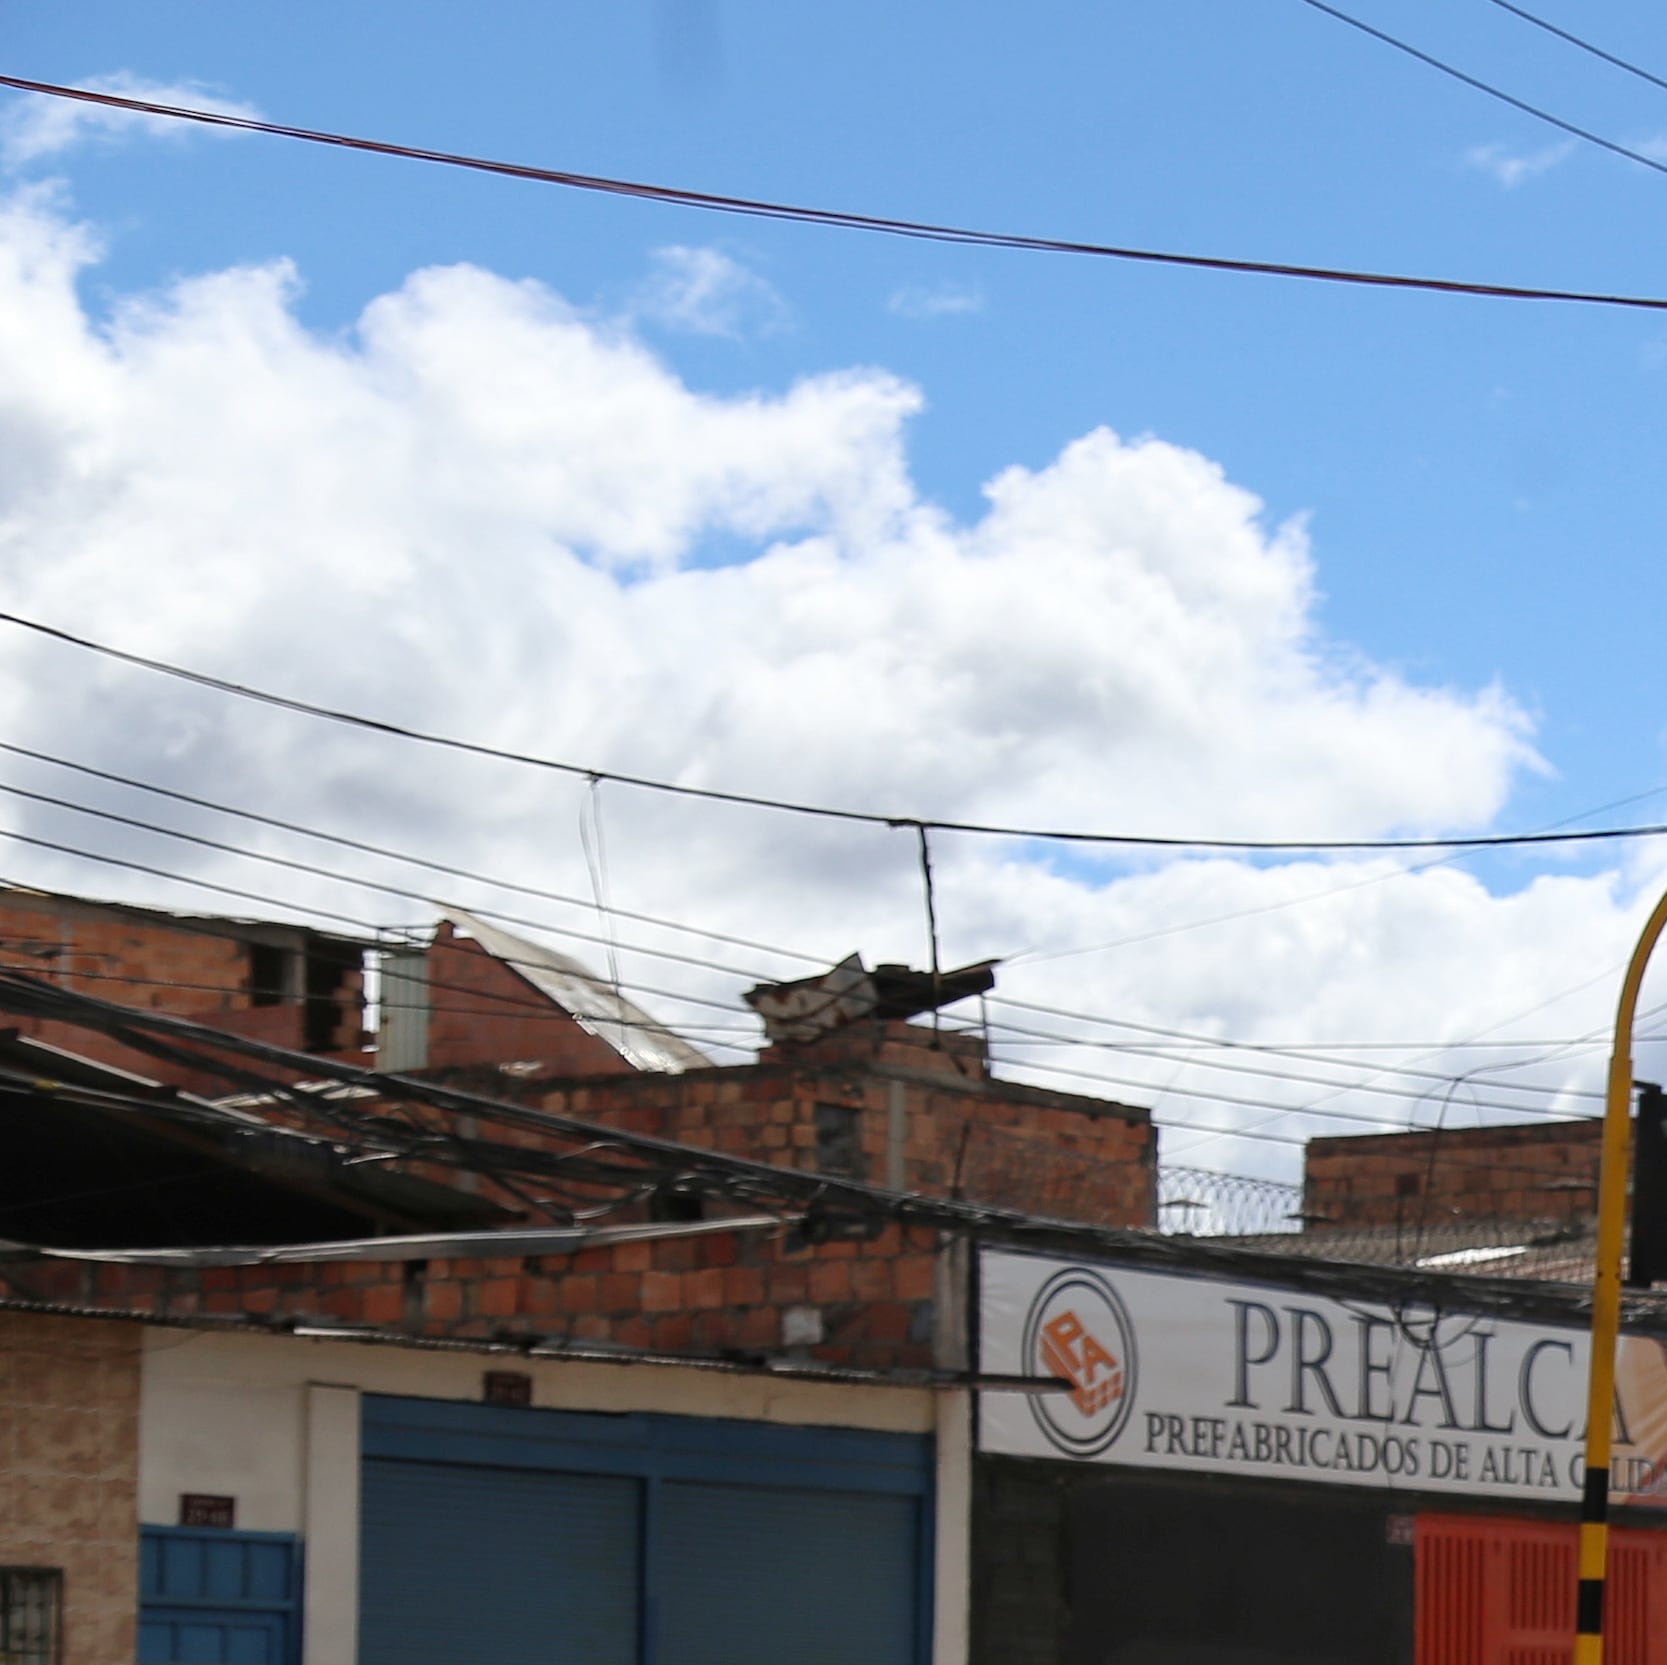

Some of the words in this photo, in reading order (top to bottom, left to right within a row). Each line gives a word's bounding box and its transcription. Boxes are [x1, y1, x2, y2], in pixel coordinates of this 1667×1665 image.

[1144, 1412, 1419, 1477] PREFABRICADOS
[1428, 1440, 1470, 1481] DE
[1478, 1446, 1559, 1489] ALTA
